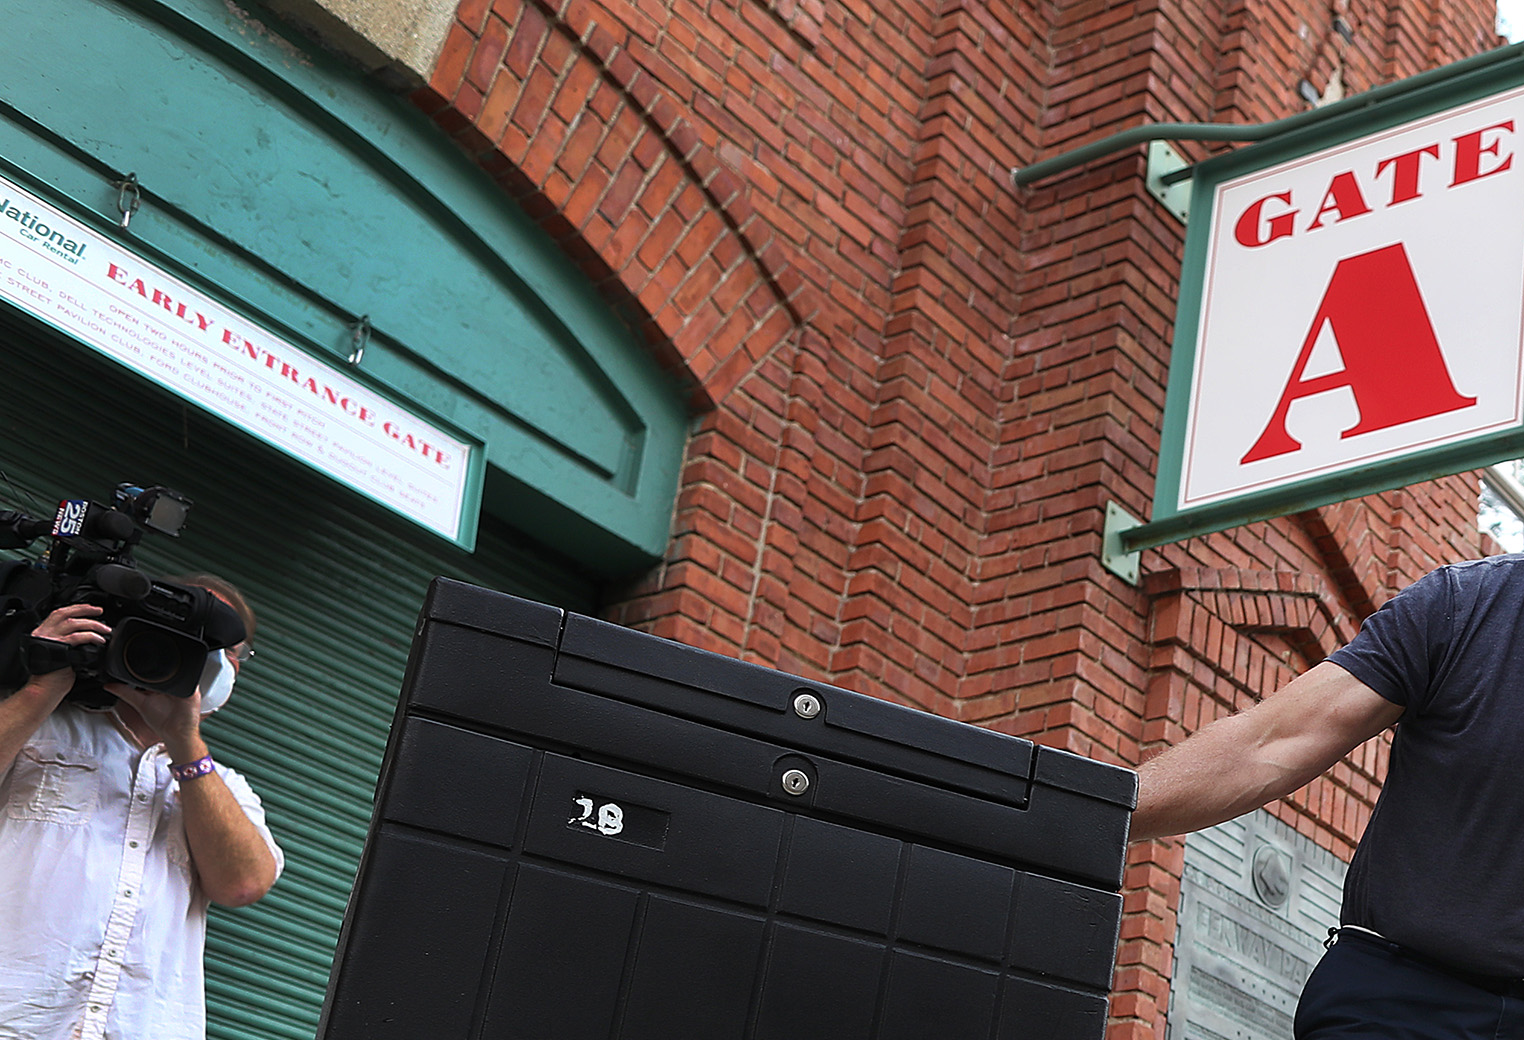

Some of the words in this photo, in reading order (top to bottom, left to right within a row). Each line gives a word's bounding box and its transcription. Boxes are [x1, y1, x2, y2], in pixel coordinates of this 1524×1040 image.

[1234, 120, 1515, 248] GATE
[19, 228, 39, 242] Car
[43, 240, 78, 265] Rental
[7, 276, 51, 305] STREET
[57, 303, 105, 335] PAVILION
[144, 324, 166, 339] TWO
[107, 263, 213, 331] EARLY
[221, 328, 376, 427] ENTRANCE
[384, 421, 452, 470] GATE
[1239, 241, 1478, 465] A
[52, 507, 65, 535] NEWS
[60, 502, 81, 534] 25
[74, 501, 89, 535] BOSTON
